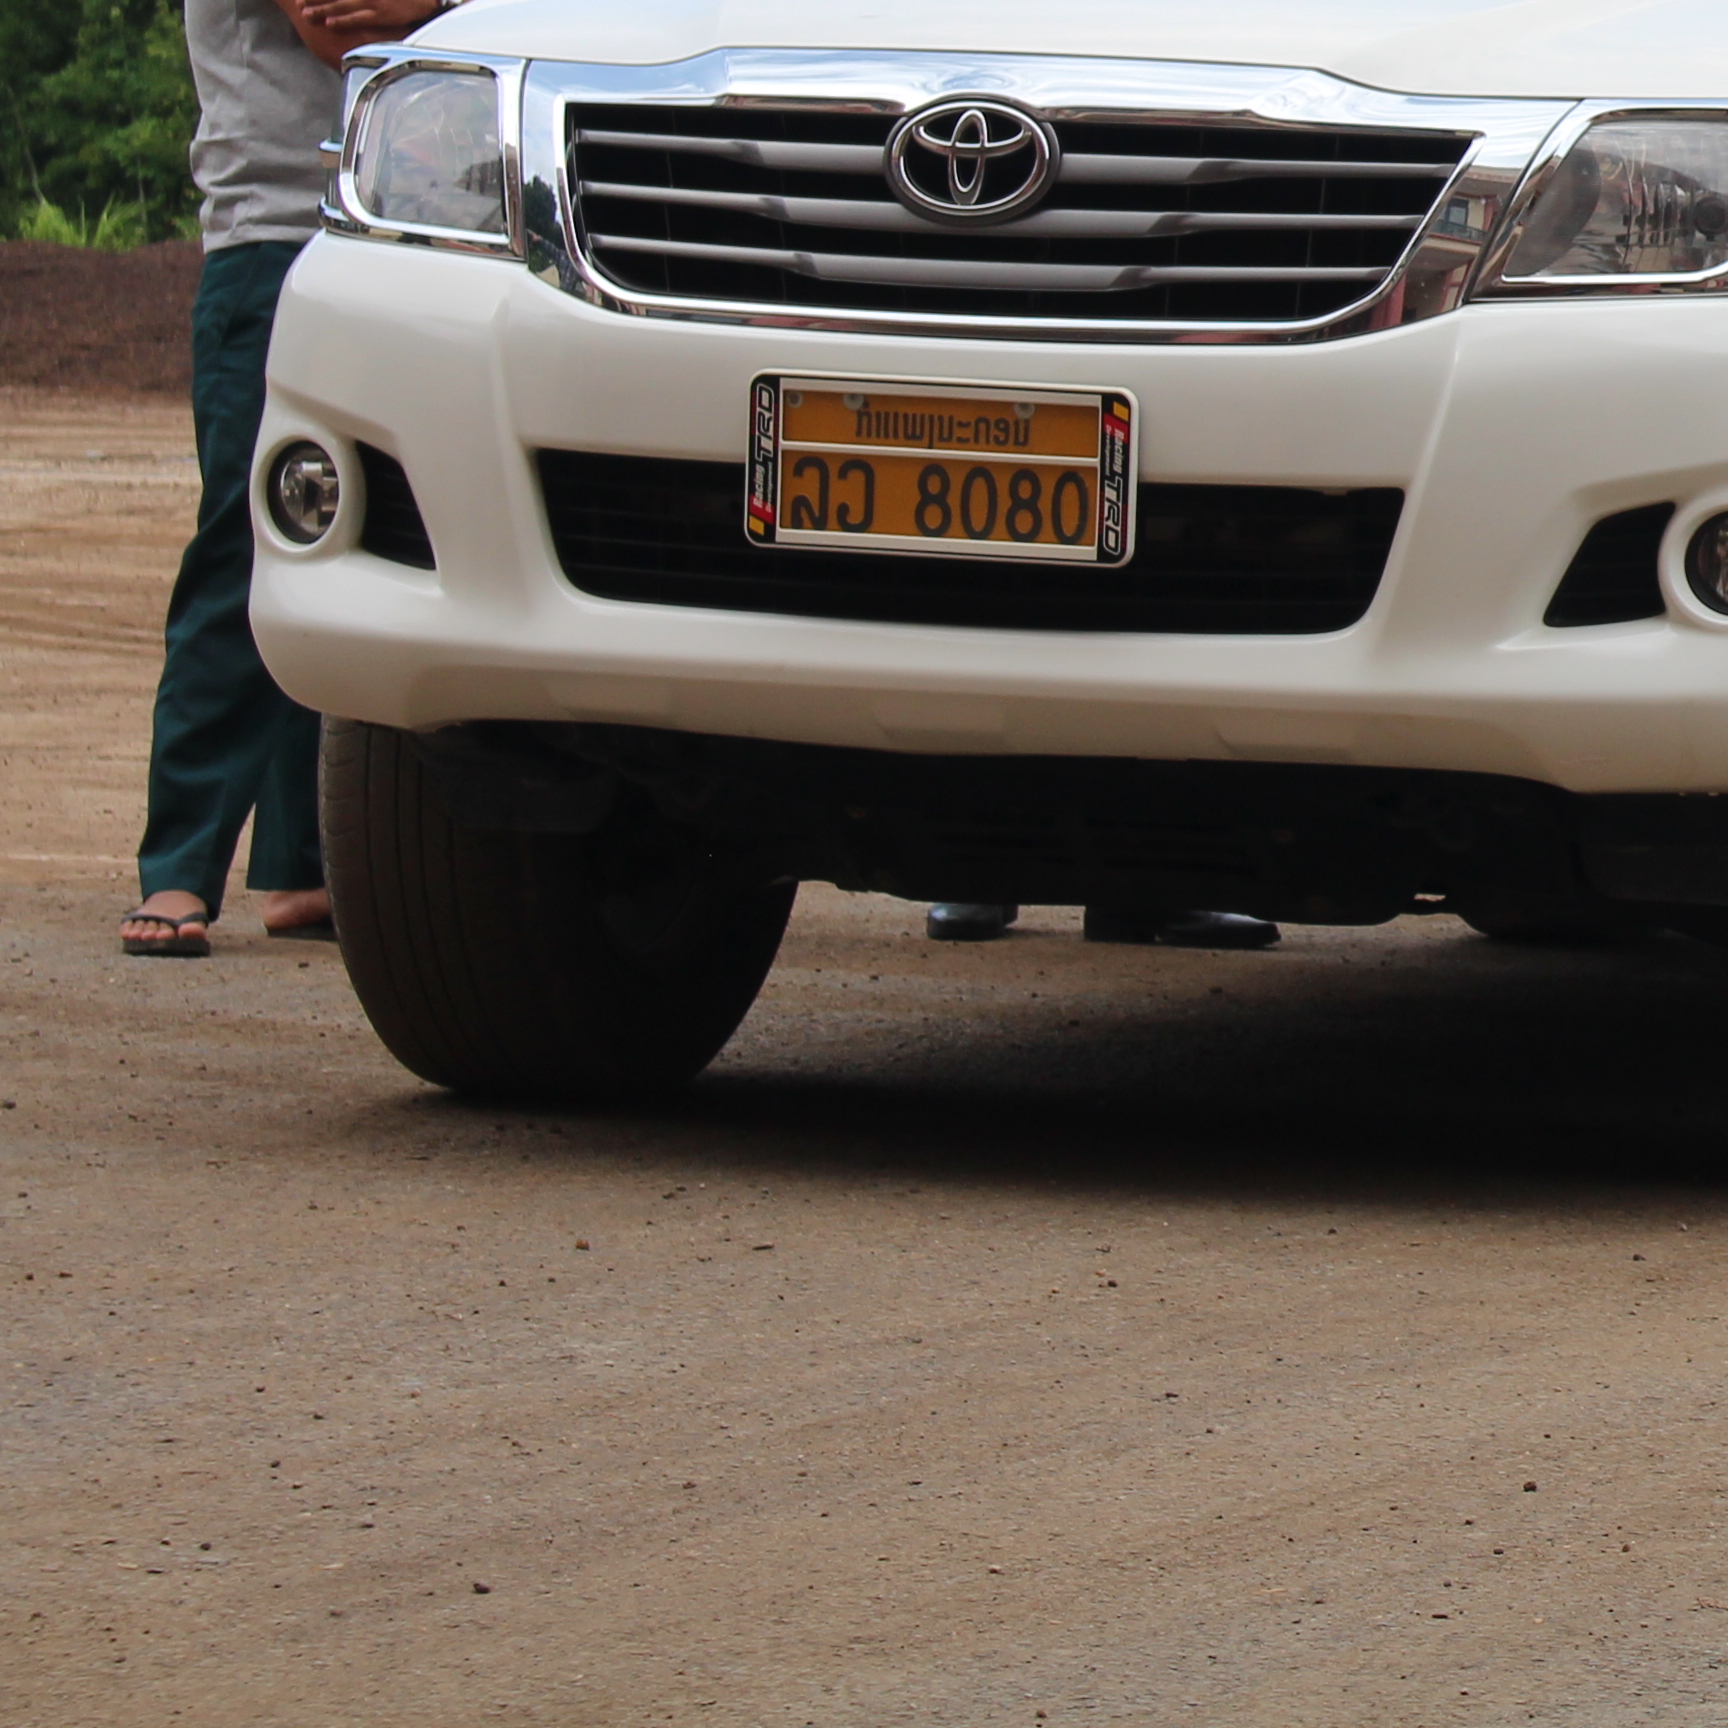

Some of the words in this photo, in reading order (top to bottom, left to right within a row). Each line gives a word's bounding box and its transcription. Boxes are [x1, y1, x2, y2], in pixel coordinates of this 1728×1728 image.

[755, 382, 775, 463] TRD
[1112, 428, 1125, 474] Racing
[753, 463, 766, 509] Racing
[914, 463, 1090, 545] 8080
[1102, 475, 1124, 556] TRD
